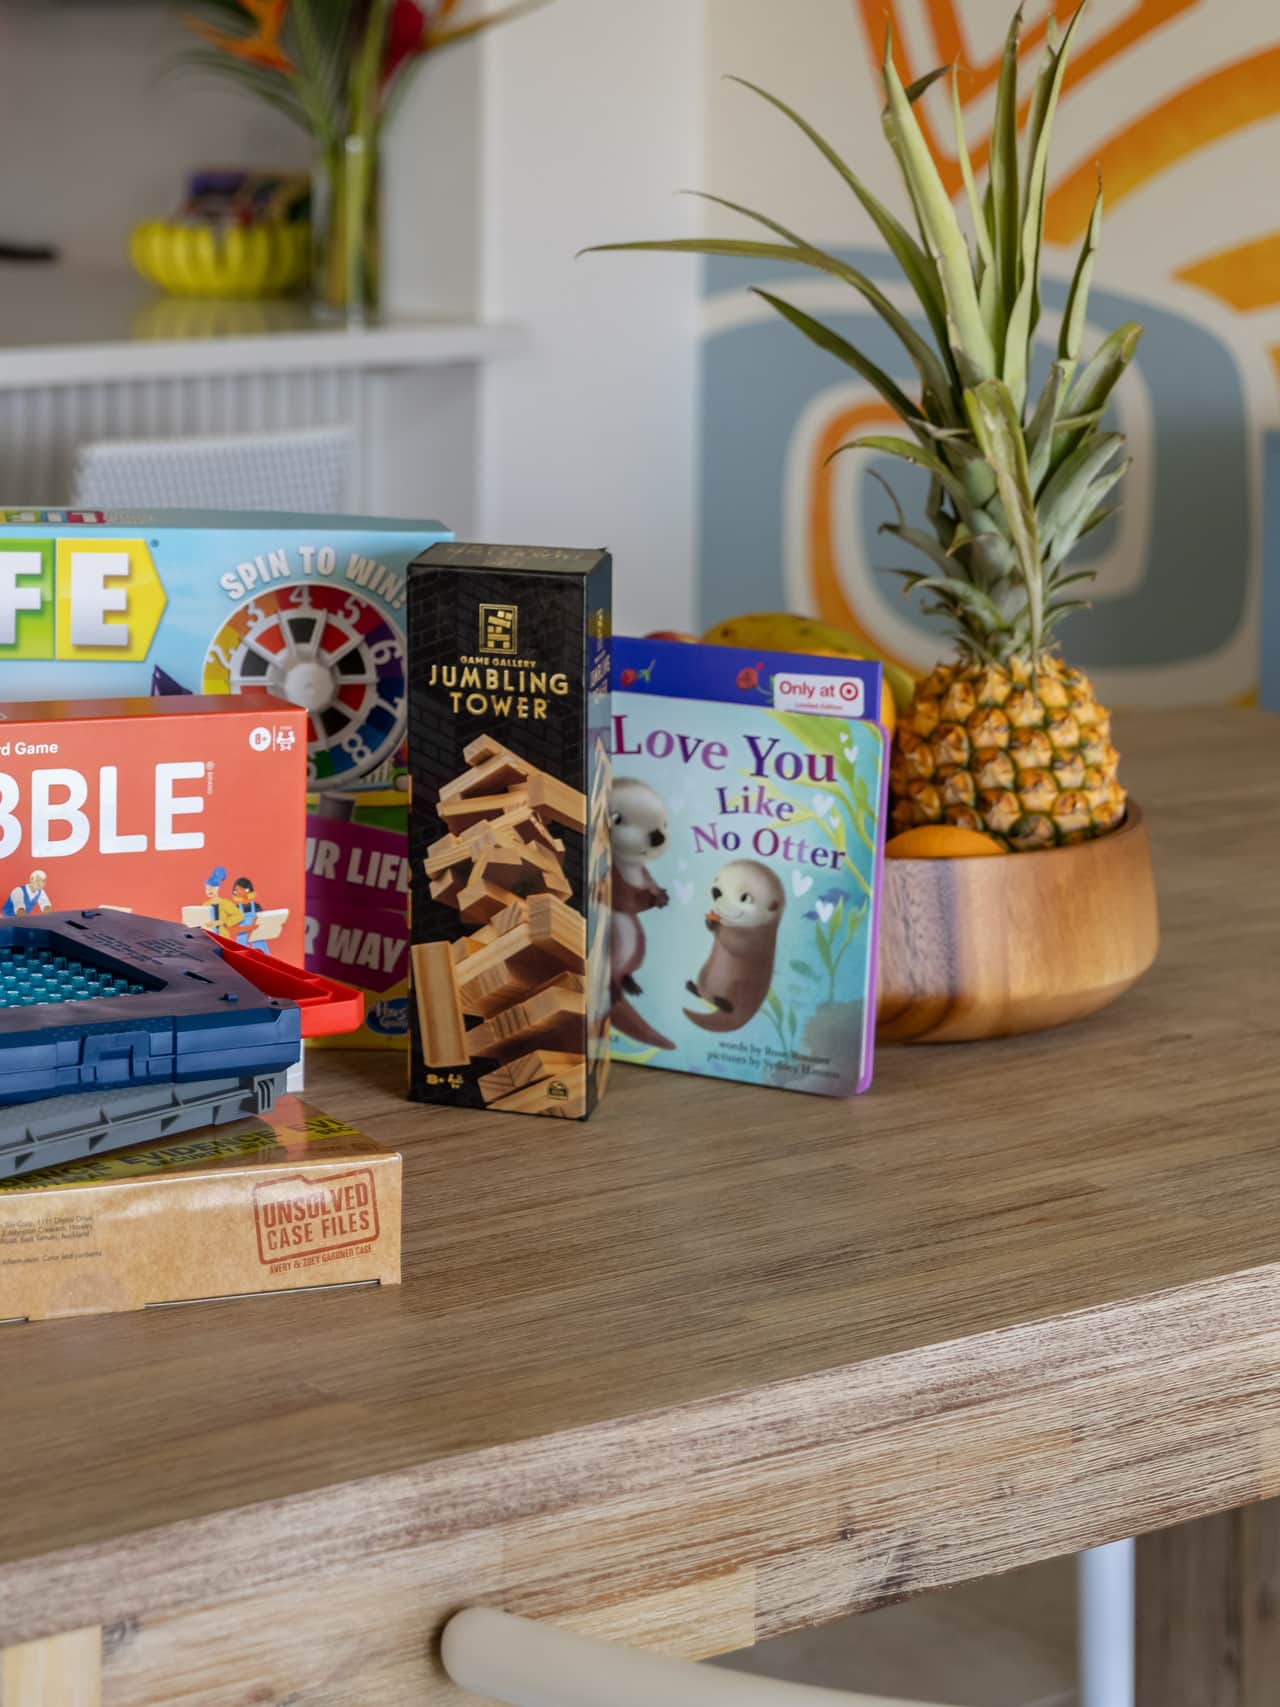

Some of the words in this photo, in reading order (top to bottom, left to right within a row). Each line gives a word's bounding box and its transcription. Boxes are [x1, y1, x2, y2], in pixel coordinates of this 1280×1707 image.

[220, 548, 291, 601] SPIN
[299, 546, 337, 577] TO
[428, 664, 569, 696] JUMBLING
[460, 655, 490, 666] GAME
[492, 658, 537, 669] GALLERY
[449, 692, 549, 720] TOWER
[779, 680, 815, 699] Only
[820, 684, 835, 698] at
[15, 740, 59, 757] Game
[610, 714, 729, 771] Love
[743, 735, 838, 783] You
[716, 785, 795, 822] Like
[691, 822, 741, 854] No
[752, 827, 846, 871] Otter
[326, 923, 407, 974] WAY
[263, 1182, 369, 1228] UNSOLVED
[266, 1222, 313, 1251] CASE
[322, 1210, 370, 1239] FILES
